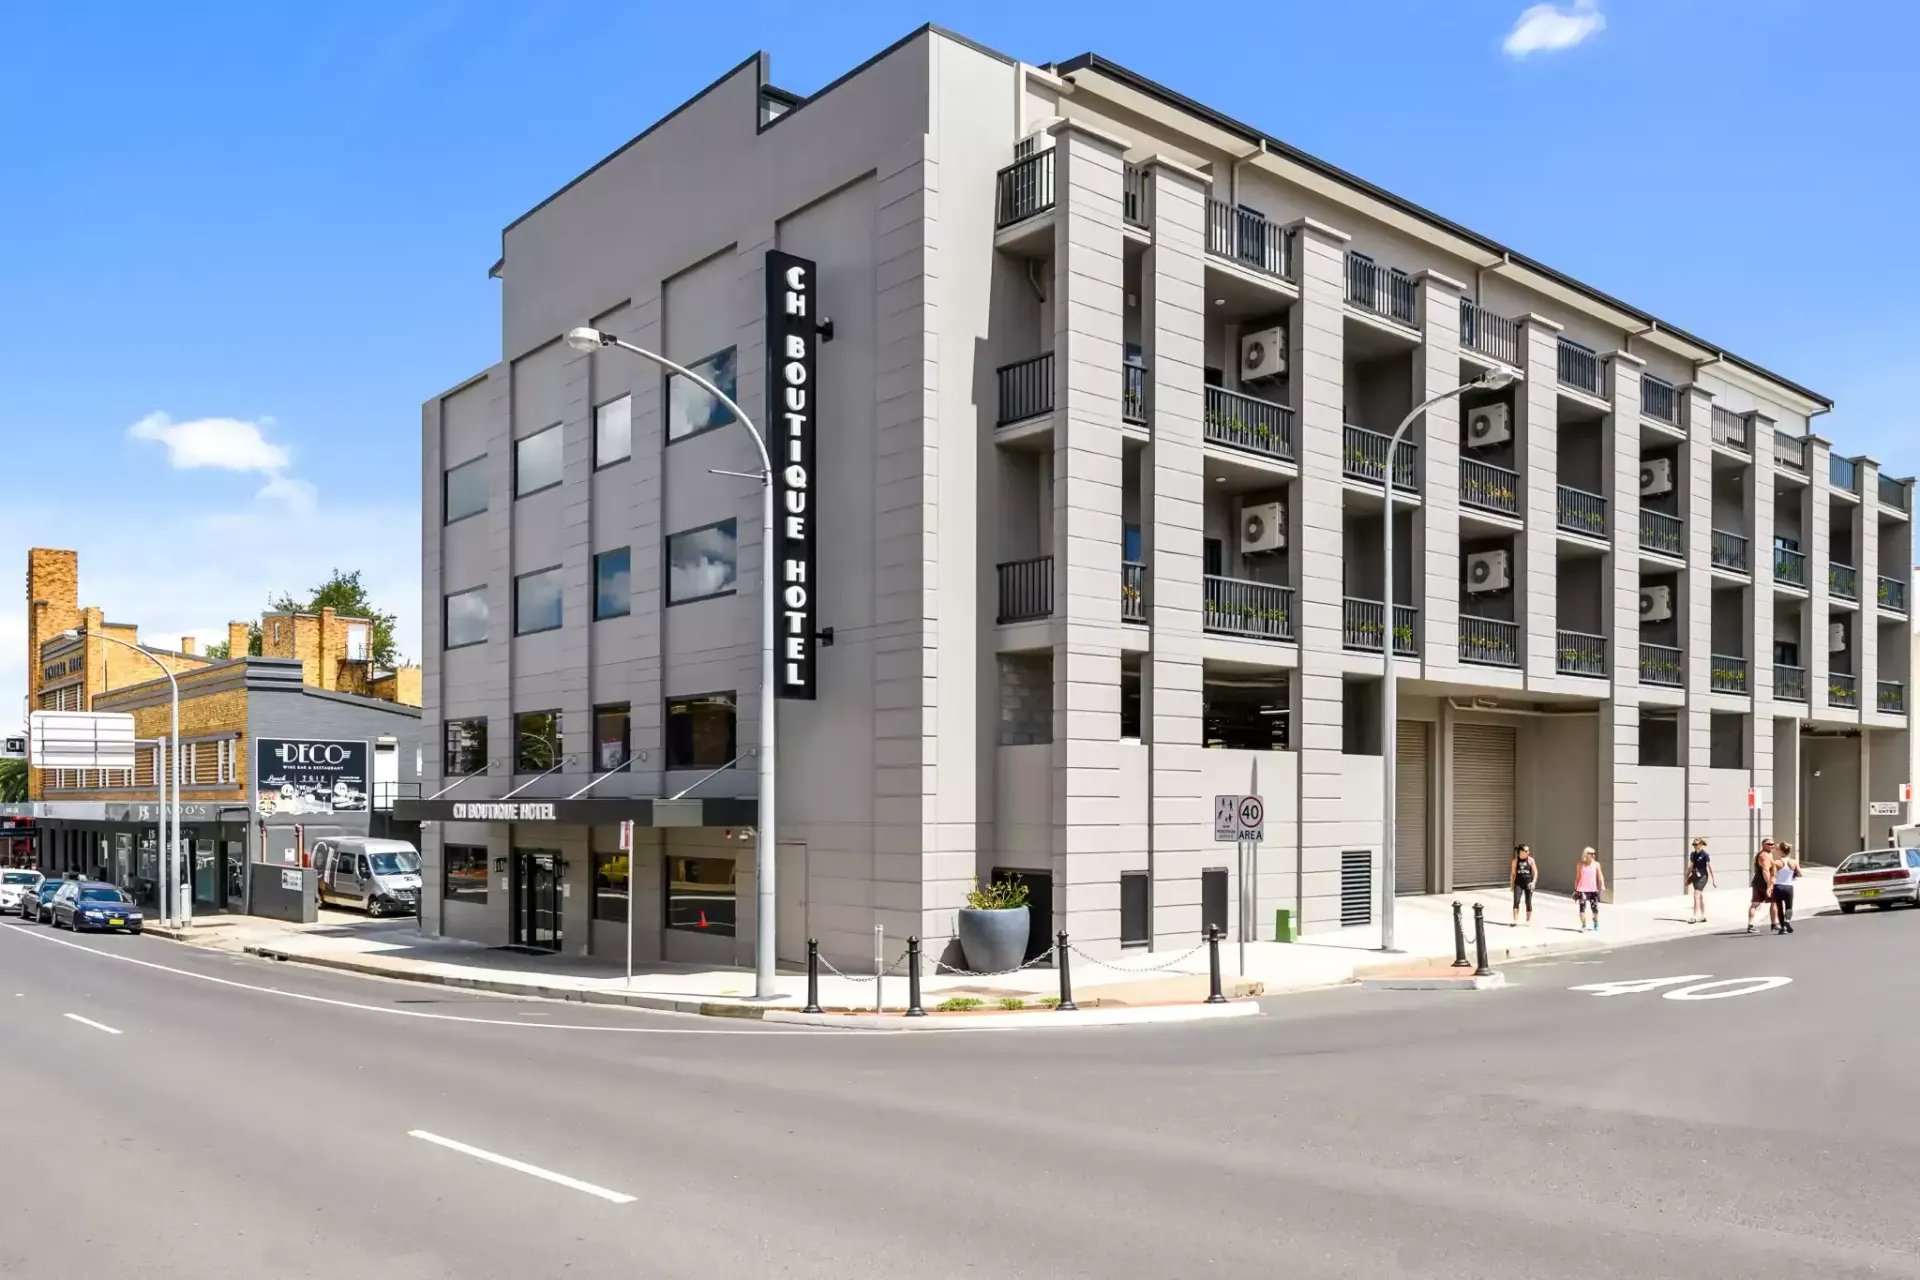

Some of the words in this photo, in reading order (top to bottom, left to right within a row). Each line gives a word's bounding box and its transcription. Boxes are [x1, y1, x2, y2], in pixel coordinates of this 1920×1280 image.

[786, 266, 806, 317] CH
[785, 334, 807, 540] BOUTIQUE
[784, 559, 807, 685] HOTEL
[281, 743, 345, 764] DECO
[453, 803, 467, 818] CH
[468, 803, 519, 819] BOUTIQUE
[520, 803, 556, 820] HOTEL
[1242, 805, 1259, 820] 40
[1238, 830, 1263, 840] AREA
[1566, 974, 1794, 1001] 40
